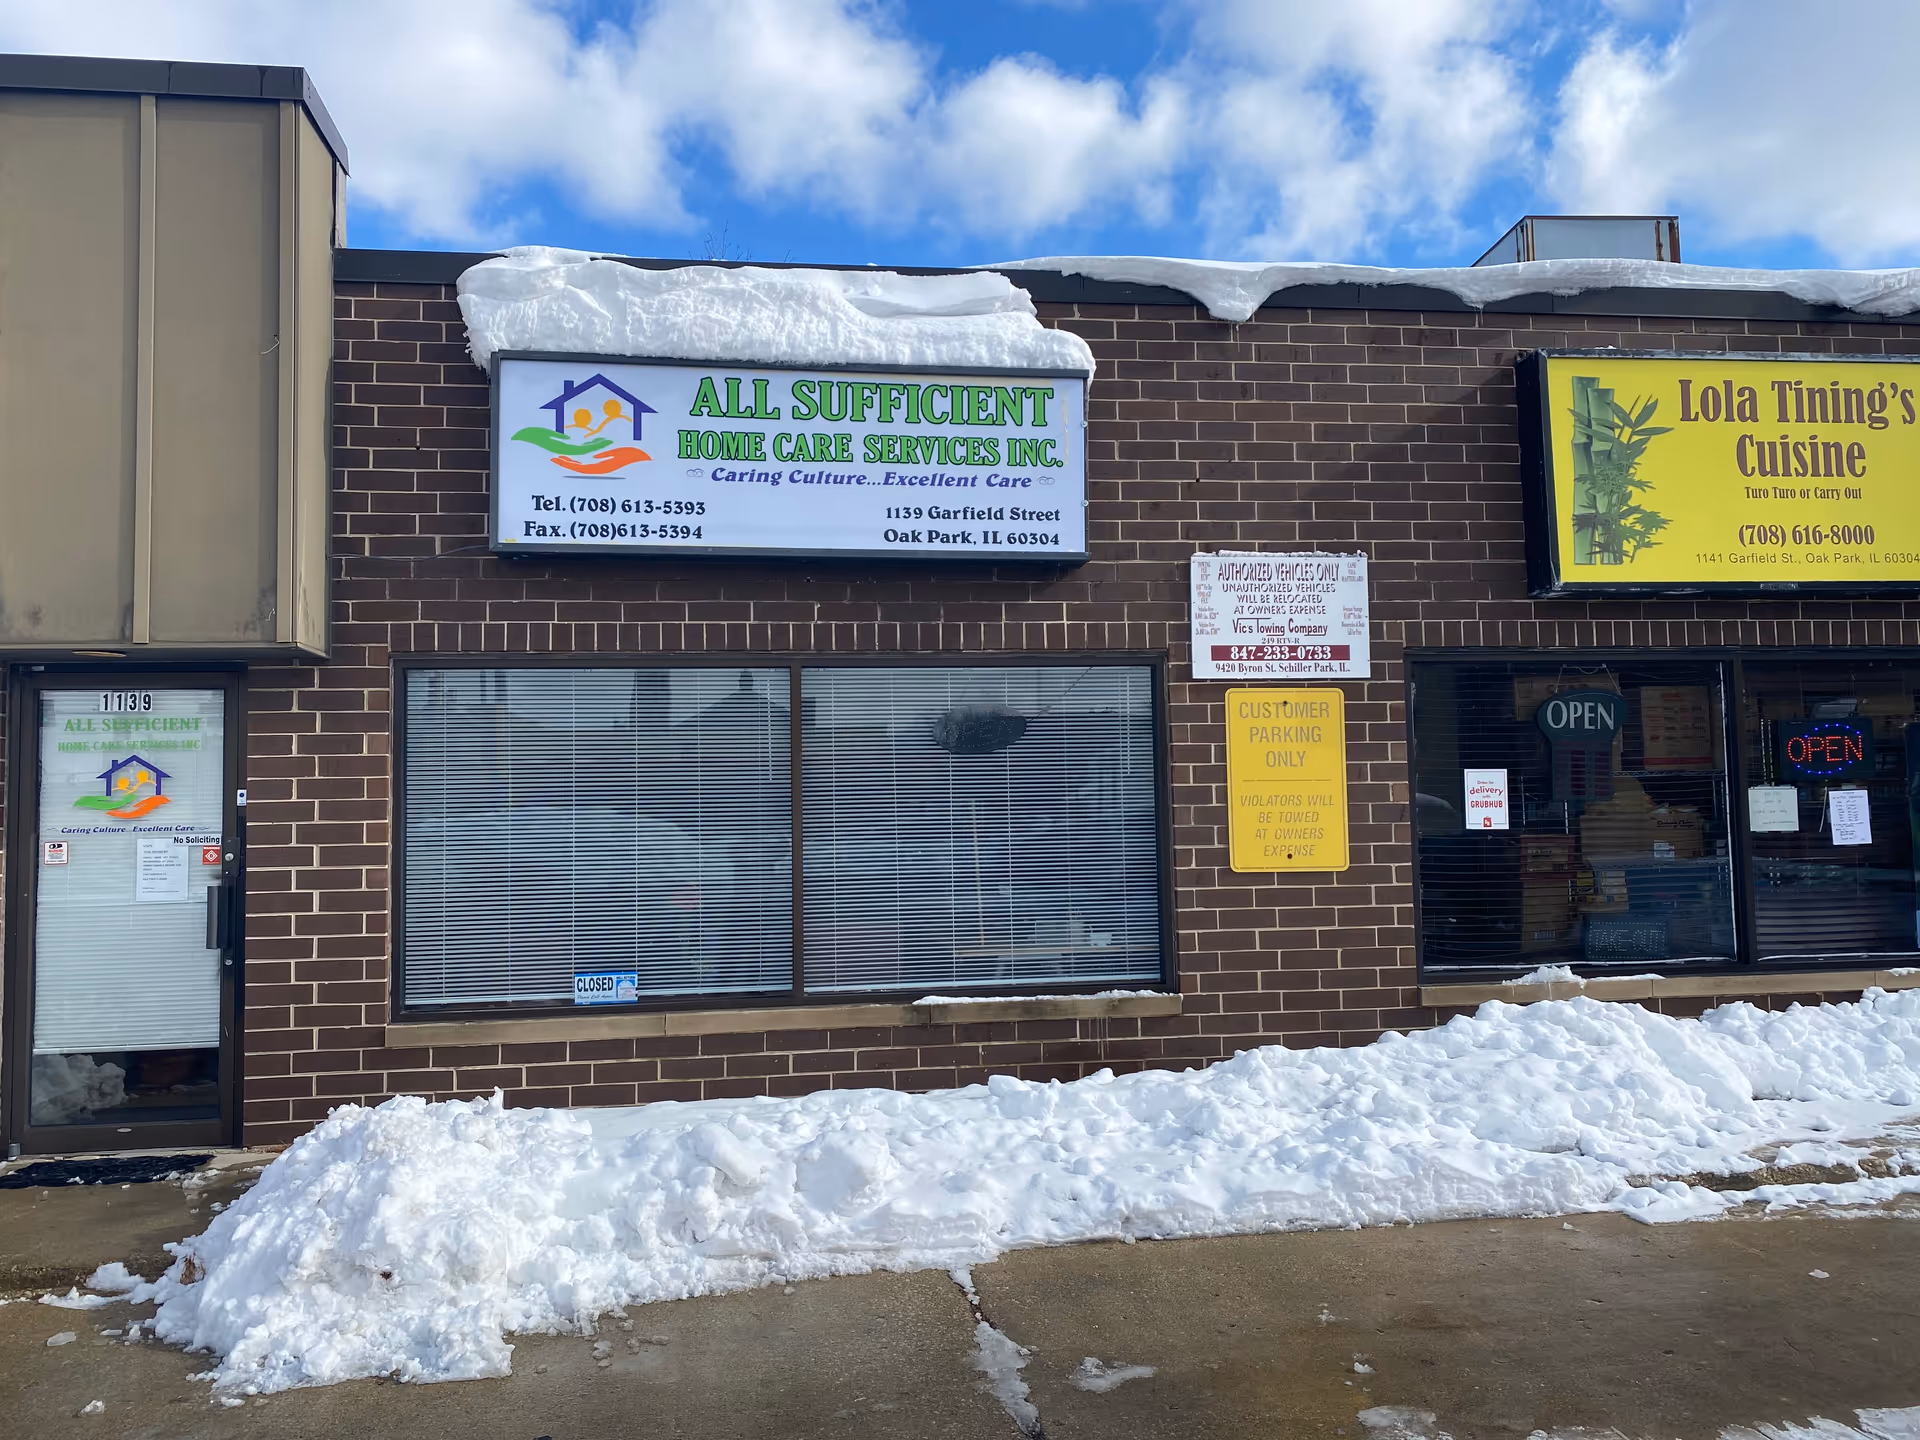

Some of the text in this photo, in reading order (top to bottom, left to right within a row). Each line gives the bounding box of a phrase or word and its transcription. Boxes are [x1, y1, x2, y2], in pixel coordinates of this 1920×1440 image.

[689, 376, 1054, 426] ALL SUFFICIENT
[1678, 379, 1916, 430] Lola Tining's
[678, 430, 1064, 467] HOME CARE SERVICES INC.
[1736, 434, 1867, 478] Cuisine
[711, 467, 783, 486] Caring
[986, 473, 1032, 488] Care
[1744, 486, 1862, 500] Turo Turo or Carry Out
[531, 495, 706, 515] Tel. (708) 613-5393
[886, 505, 1061, 521] 1139 Garfield Street
[523, 520, 566, 537] Fax.
[1738, 524, 1876, 547] (708) 616-8000
[883, 528, 1060, 545] Oak Park, IL 60304
[1696, 553, 1723, 563] 1141
[1728, 553, 1777, 564] Garfield
[1805, 553, 1830, 564] Oak
[1834, 553, 1865, 564] Park,
[1869, 553, 1881, 563] IL
[1884, 553, 1920, 563] 60304
[1218, 562, 1340, 581] AUTHORIZED VEHICLES ONLY
[1222, 583, 1293, 592] UNAUTHORIZED
[1295, 583, 1336, 593] VEHICLES
[1236, 594, 1323, 604] WILL BE RELOCATED
[1233, 605, 1326, 615] AT OWNERS EXPENSE
[1232, 617, 1254, 634] Vic's
[1256, 618, 1286, 635] Towing
[1288, 617, 1329, 636] Company
[1230, 645, 1332, 660] 847-233-0733
[1215, 663, 1236, 673] 9420
[1238, 663, 1262, 675] Byron
[1265, 663, 1277, 673] St.
[1278, 662, 1312, 673] Schiller
[1314, 663, 1338, 674] Park,
[103, 693, 152, 711] 1139
[1239, 701, 1330, 719] CUSTOMER
[1546, 700, 1614, 730] OPEN
[64, 717, 202, 732] ALL SUFFICIENT
[1249, 726, 1322, 743] PARKING
[57, 741, 90, 751] HOME
[1787, 735, 1863, 762] OPEN
[1265, 750, 1307, 768] ONLY
[1469, 785, 1504, 796] delivery
[1240, 794, 1335, 807] VIOLATORS WILL
[1470, 800, 1503, 808] GRUBHUB
[1258, 811, 1320, 823] BE TOWED
[61, 827, 91, 835] Caring
[174, 824, 195, 832] Care
[1255, 828, 1324, 840] AT OWNERS
[173, 836, 220, 844] No Soliciting
[1263, 844, 1316, 857] EXPENSE
[577, 977, 614, 992] CLOSED
